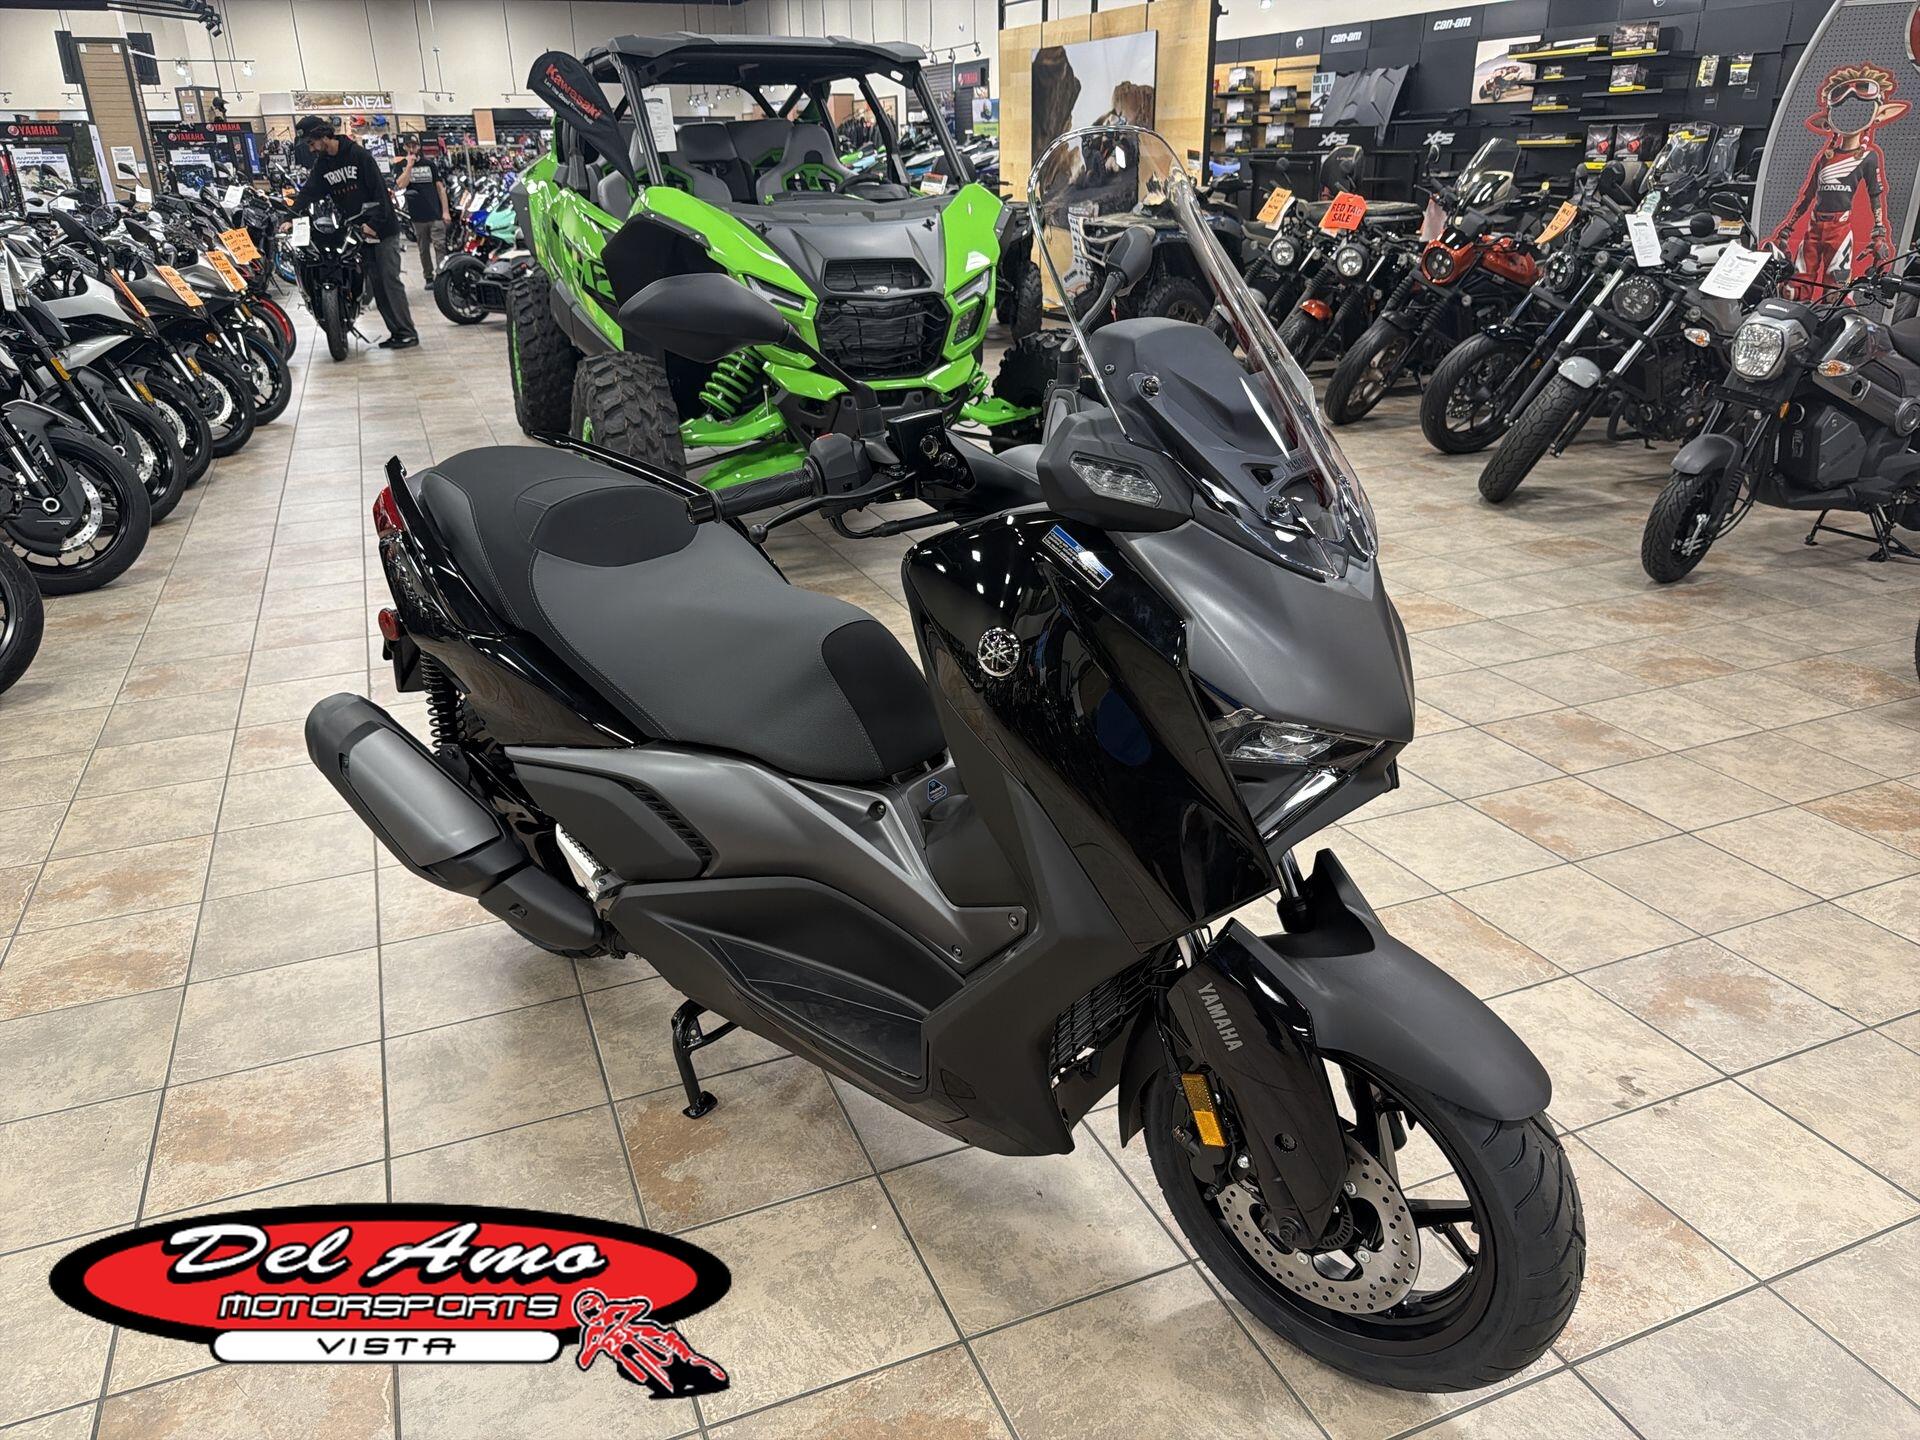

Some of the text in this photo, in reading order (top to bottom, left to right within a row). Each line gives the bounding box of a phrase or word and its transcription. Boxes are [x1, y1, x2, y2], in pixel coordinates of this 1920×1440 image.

[1433, 17, 1472, 31] can-am
[1330, 31, 1362, 44] can-am
[546, 64, 602, 119] Kawasaki
[19, 125, 59, 136] YAMAHA
[213, 123, 241, 131] YAMAHA
[176, 133, 205, 141] YAMAHA
[323, 165, 358, 186] TROY LEE
[1331, 203, 1345, 213] RED
[1332, 212, 1351, 223] SALE
[1198, 982, 1244, 1052] YAMAHA
